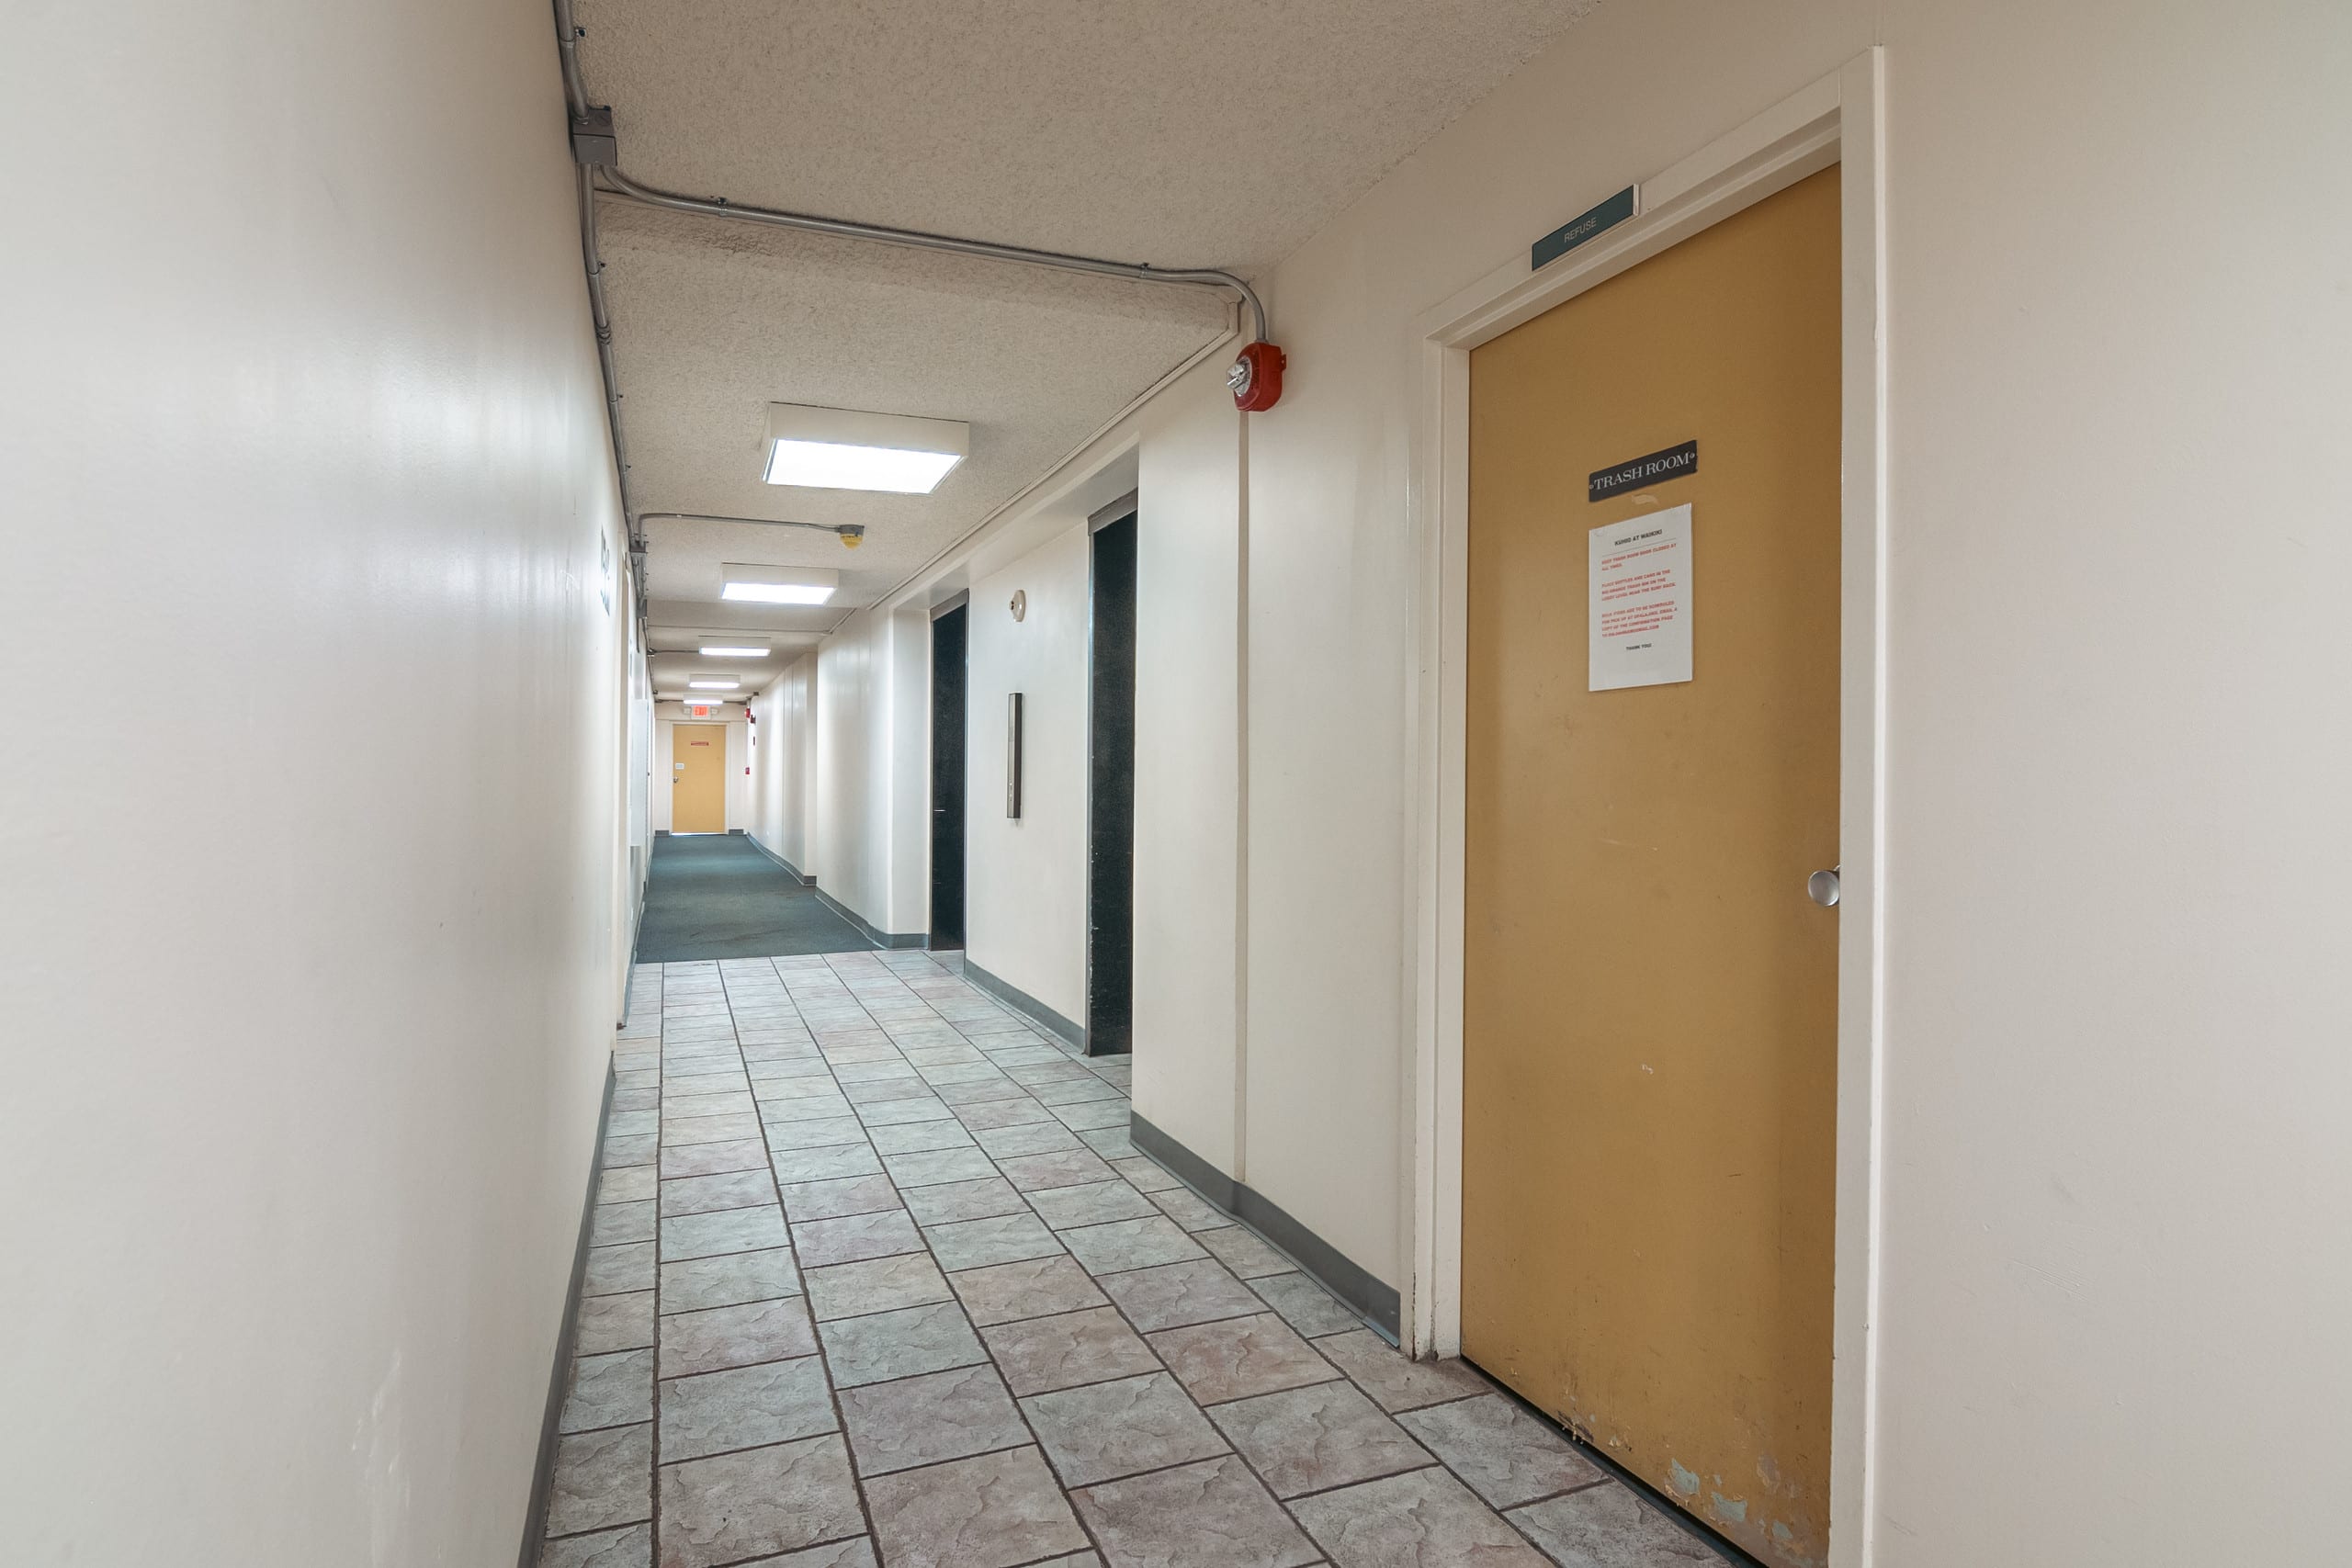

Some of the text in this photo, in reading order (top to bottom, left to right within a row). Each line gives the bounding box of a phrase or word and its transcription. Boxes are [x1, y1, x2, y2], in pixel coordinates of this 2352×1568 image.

[1564, 217, 1597, 243] REFUSE
[1594, 452, 1690, 490] TRASH ROOM
[1641, 529, 1663, 539] WAIKIKI
